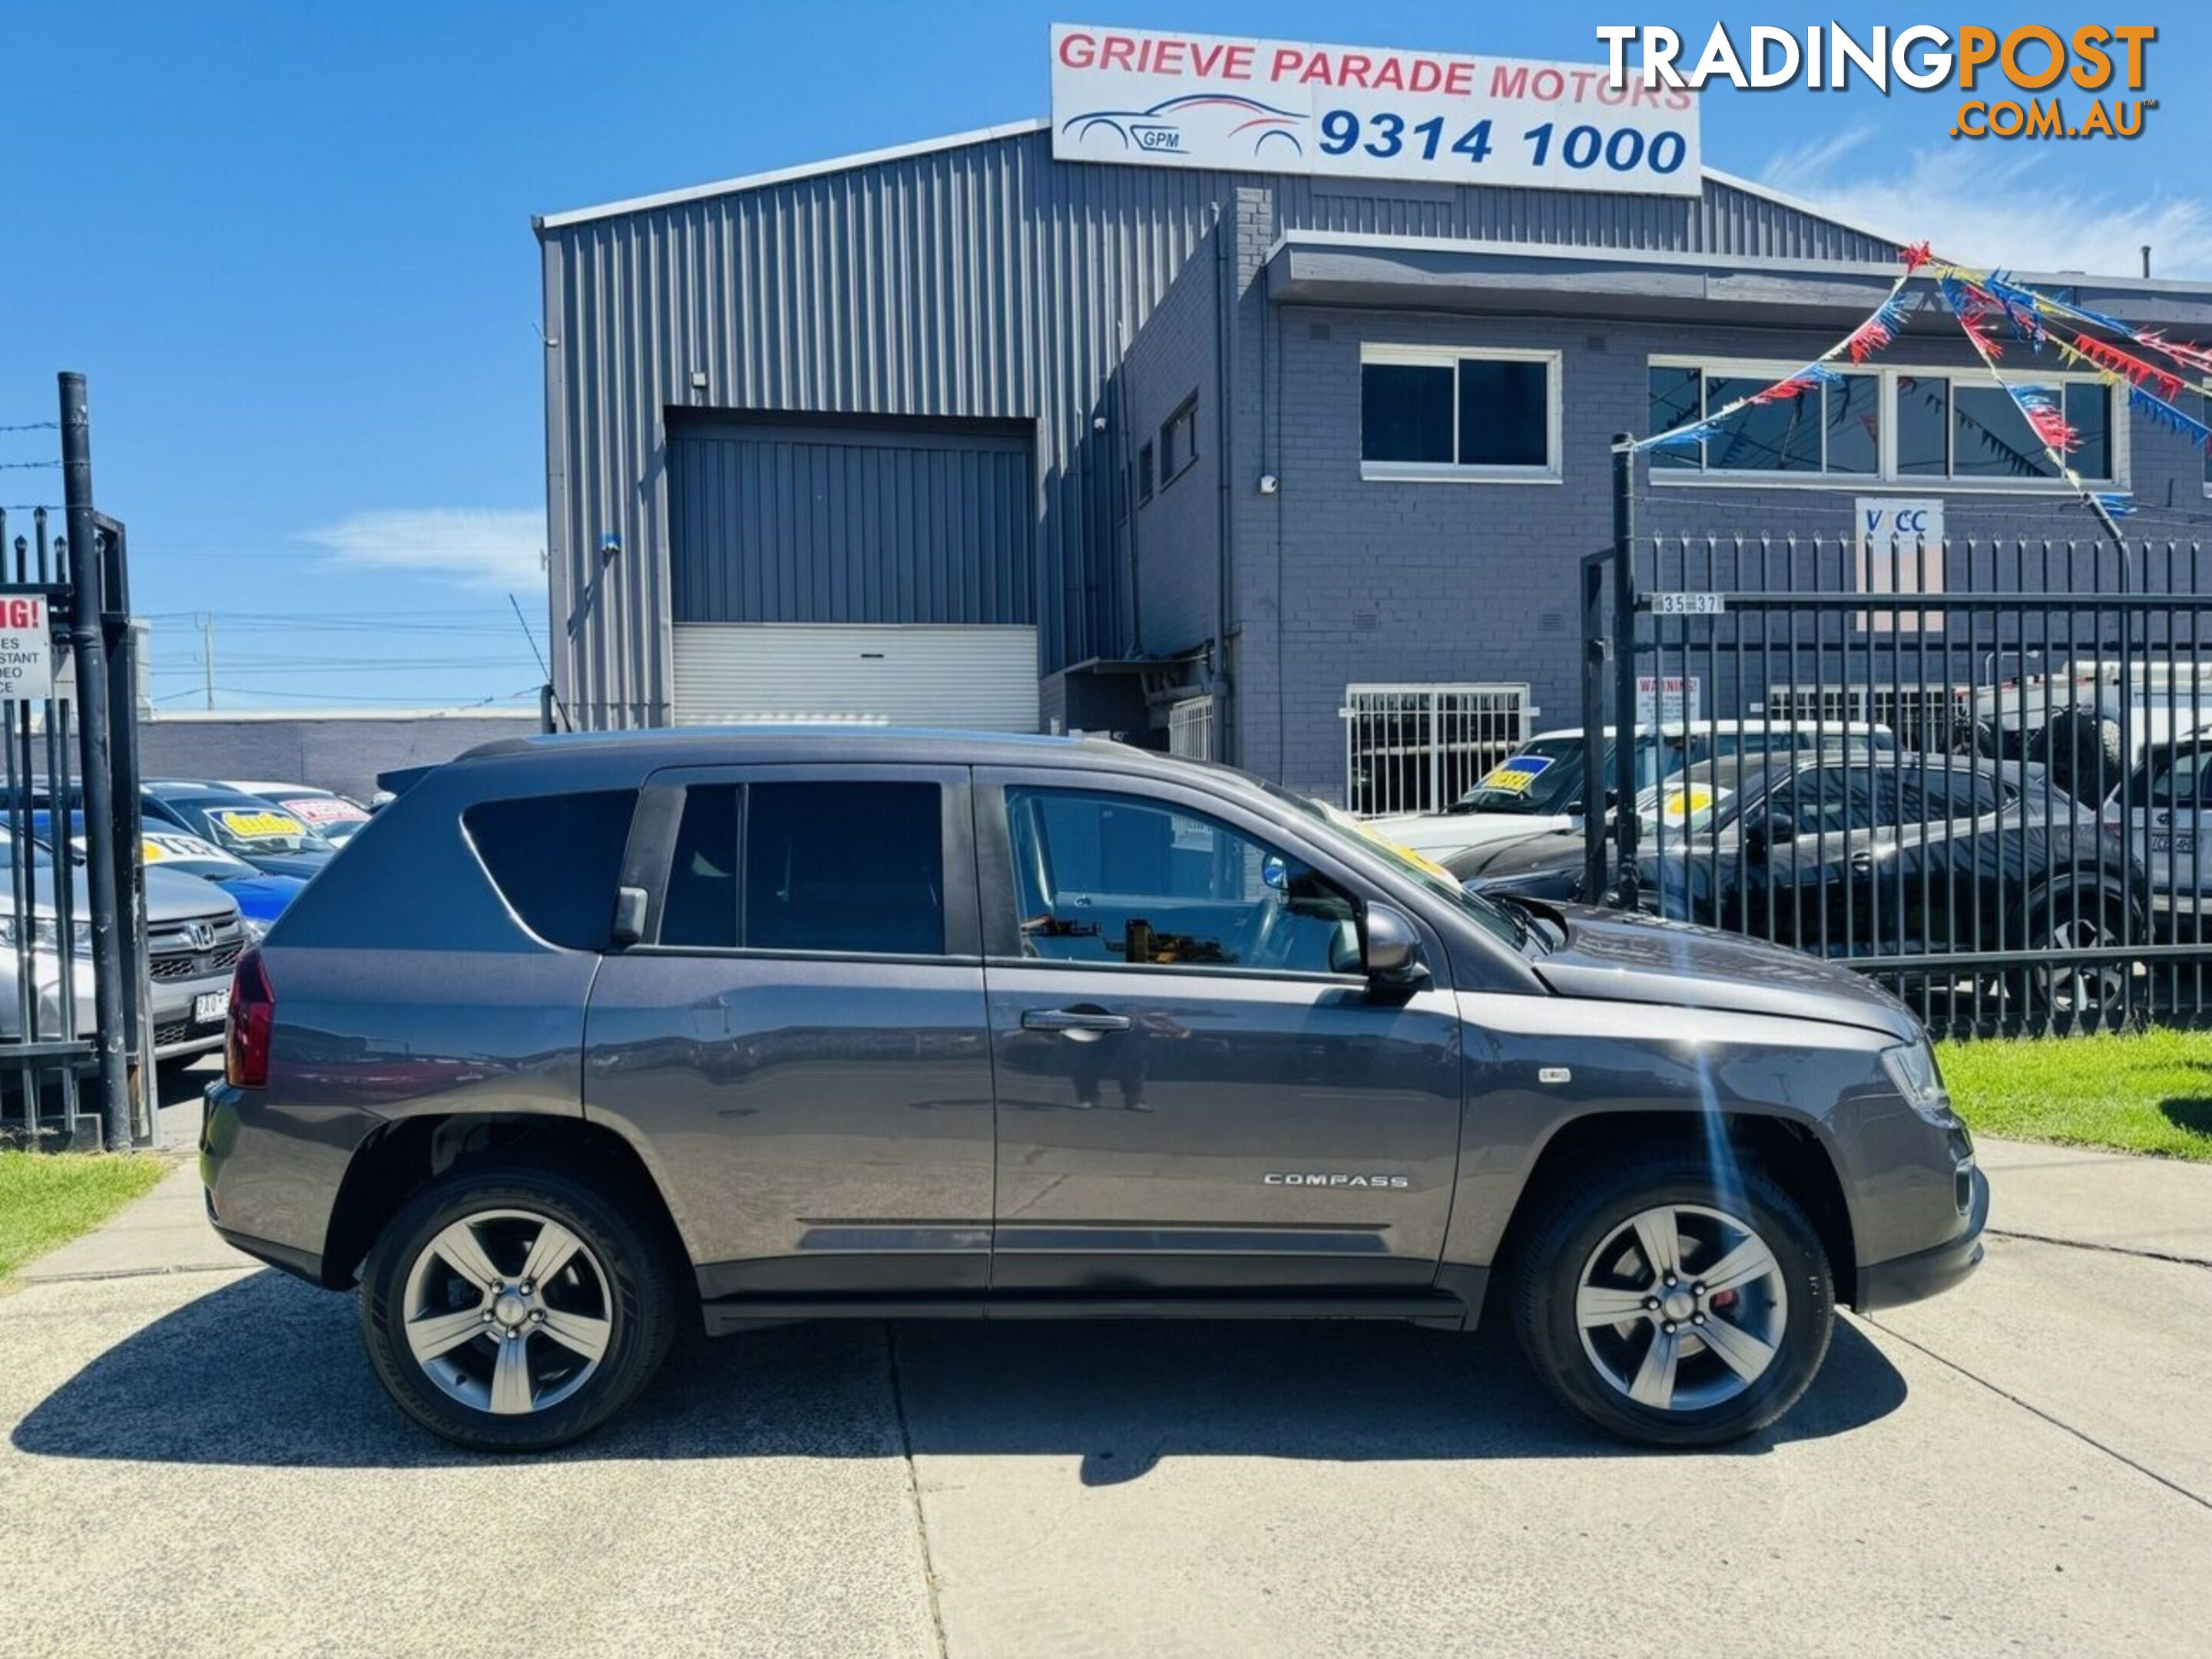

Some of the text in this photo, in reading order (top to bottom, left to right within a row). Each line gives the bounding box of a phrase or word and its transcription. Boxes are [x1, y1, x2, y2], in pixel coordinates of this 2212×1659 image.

[1058, 34, 1256, 81] GRIEVE
[1270, 48, 1475, 96] PARADE
[1143, 131, 1180, 149] GPM
[1319, 109, 1687, 174] 9314 1000
[1866, 509, 1928, 533] VCC
[1263, 1173, 1409, 1188] COMPASS
